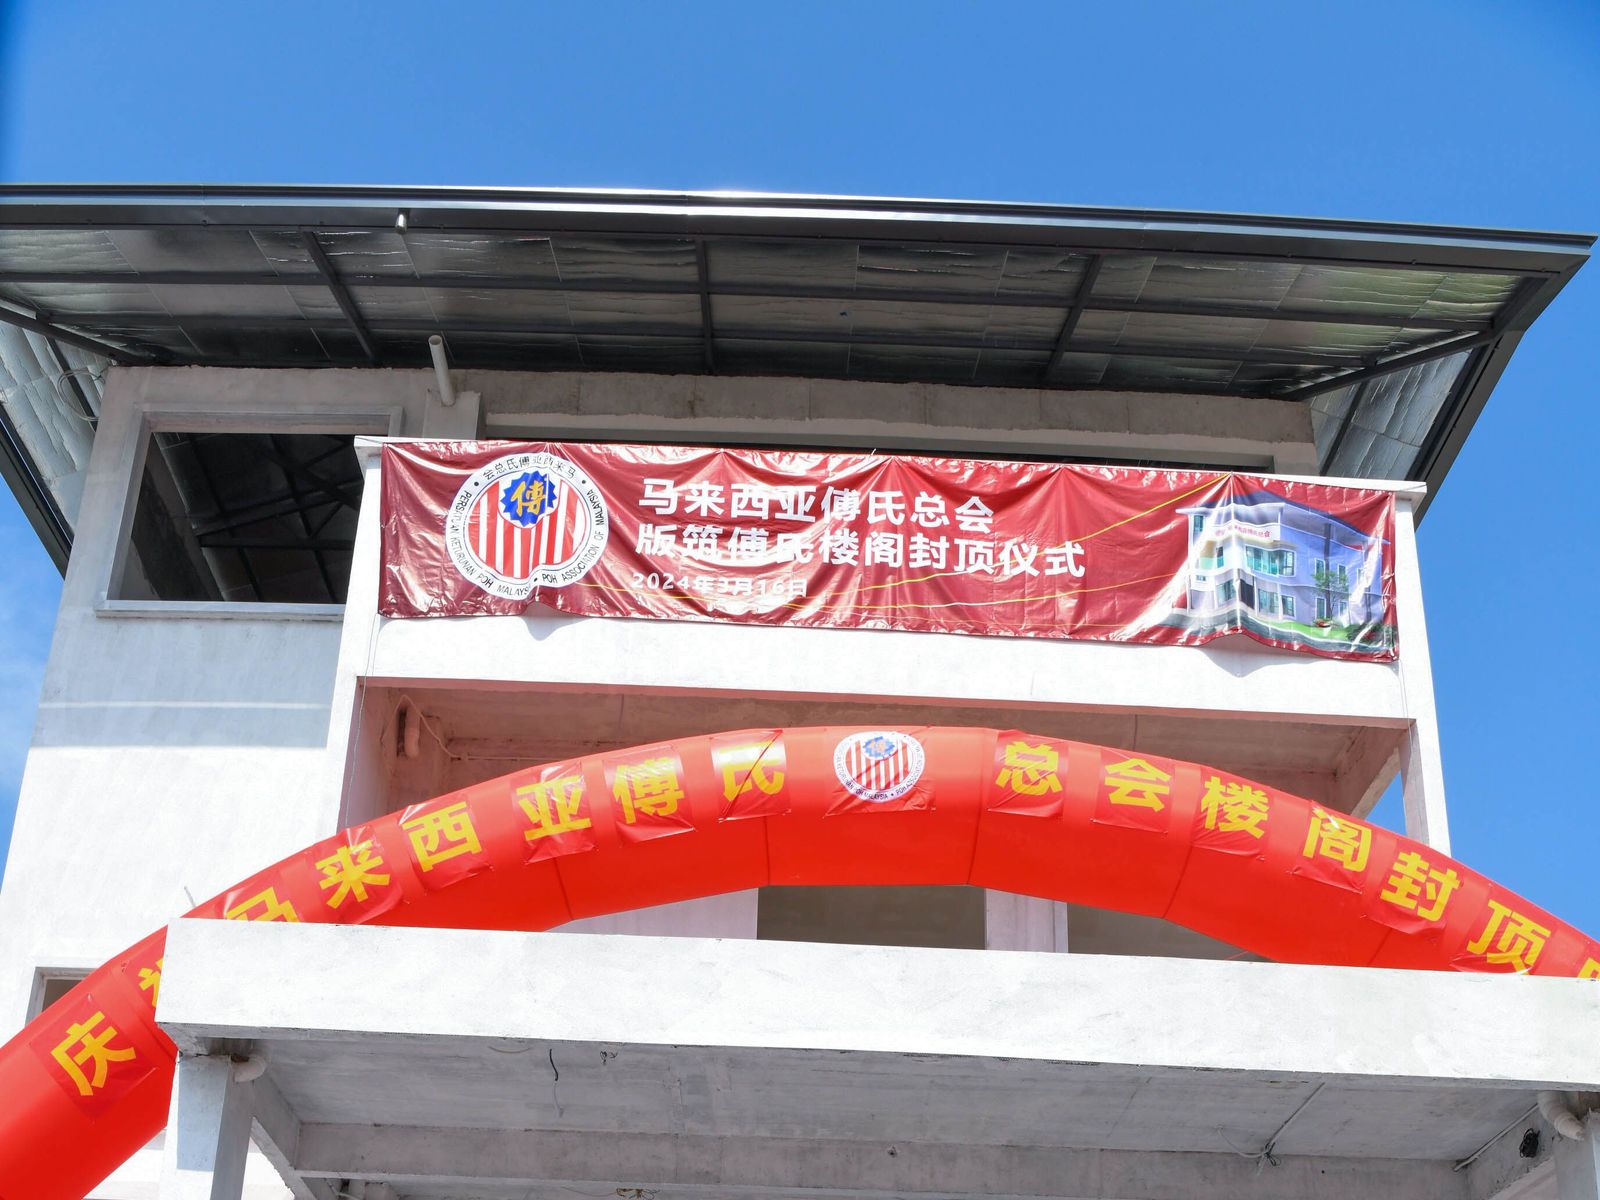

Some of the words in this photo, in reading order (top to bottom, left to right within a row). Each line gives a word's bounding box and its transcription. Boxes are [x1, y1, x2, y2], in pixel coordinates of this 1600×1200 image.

[586, 489, 605, 526] MALAYSIA
[638, 477, 994, 534] 马来西亚傅氏总会
[594, 530, 605, 541] OF
[635, 522, 1086, 579] 版筑傅氏楼阁封顶仪式
[541, 573, 558, 584] POH
[561, 544, 600, 582] ASSOCIATION
[631, 572, 808, 598] 2024年3月16日
